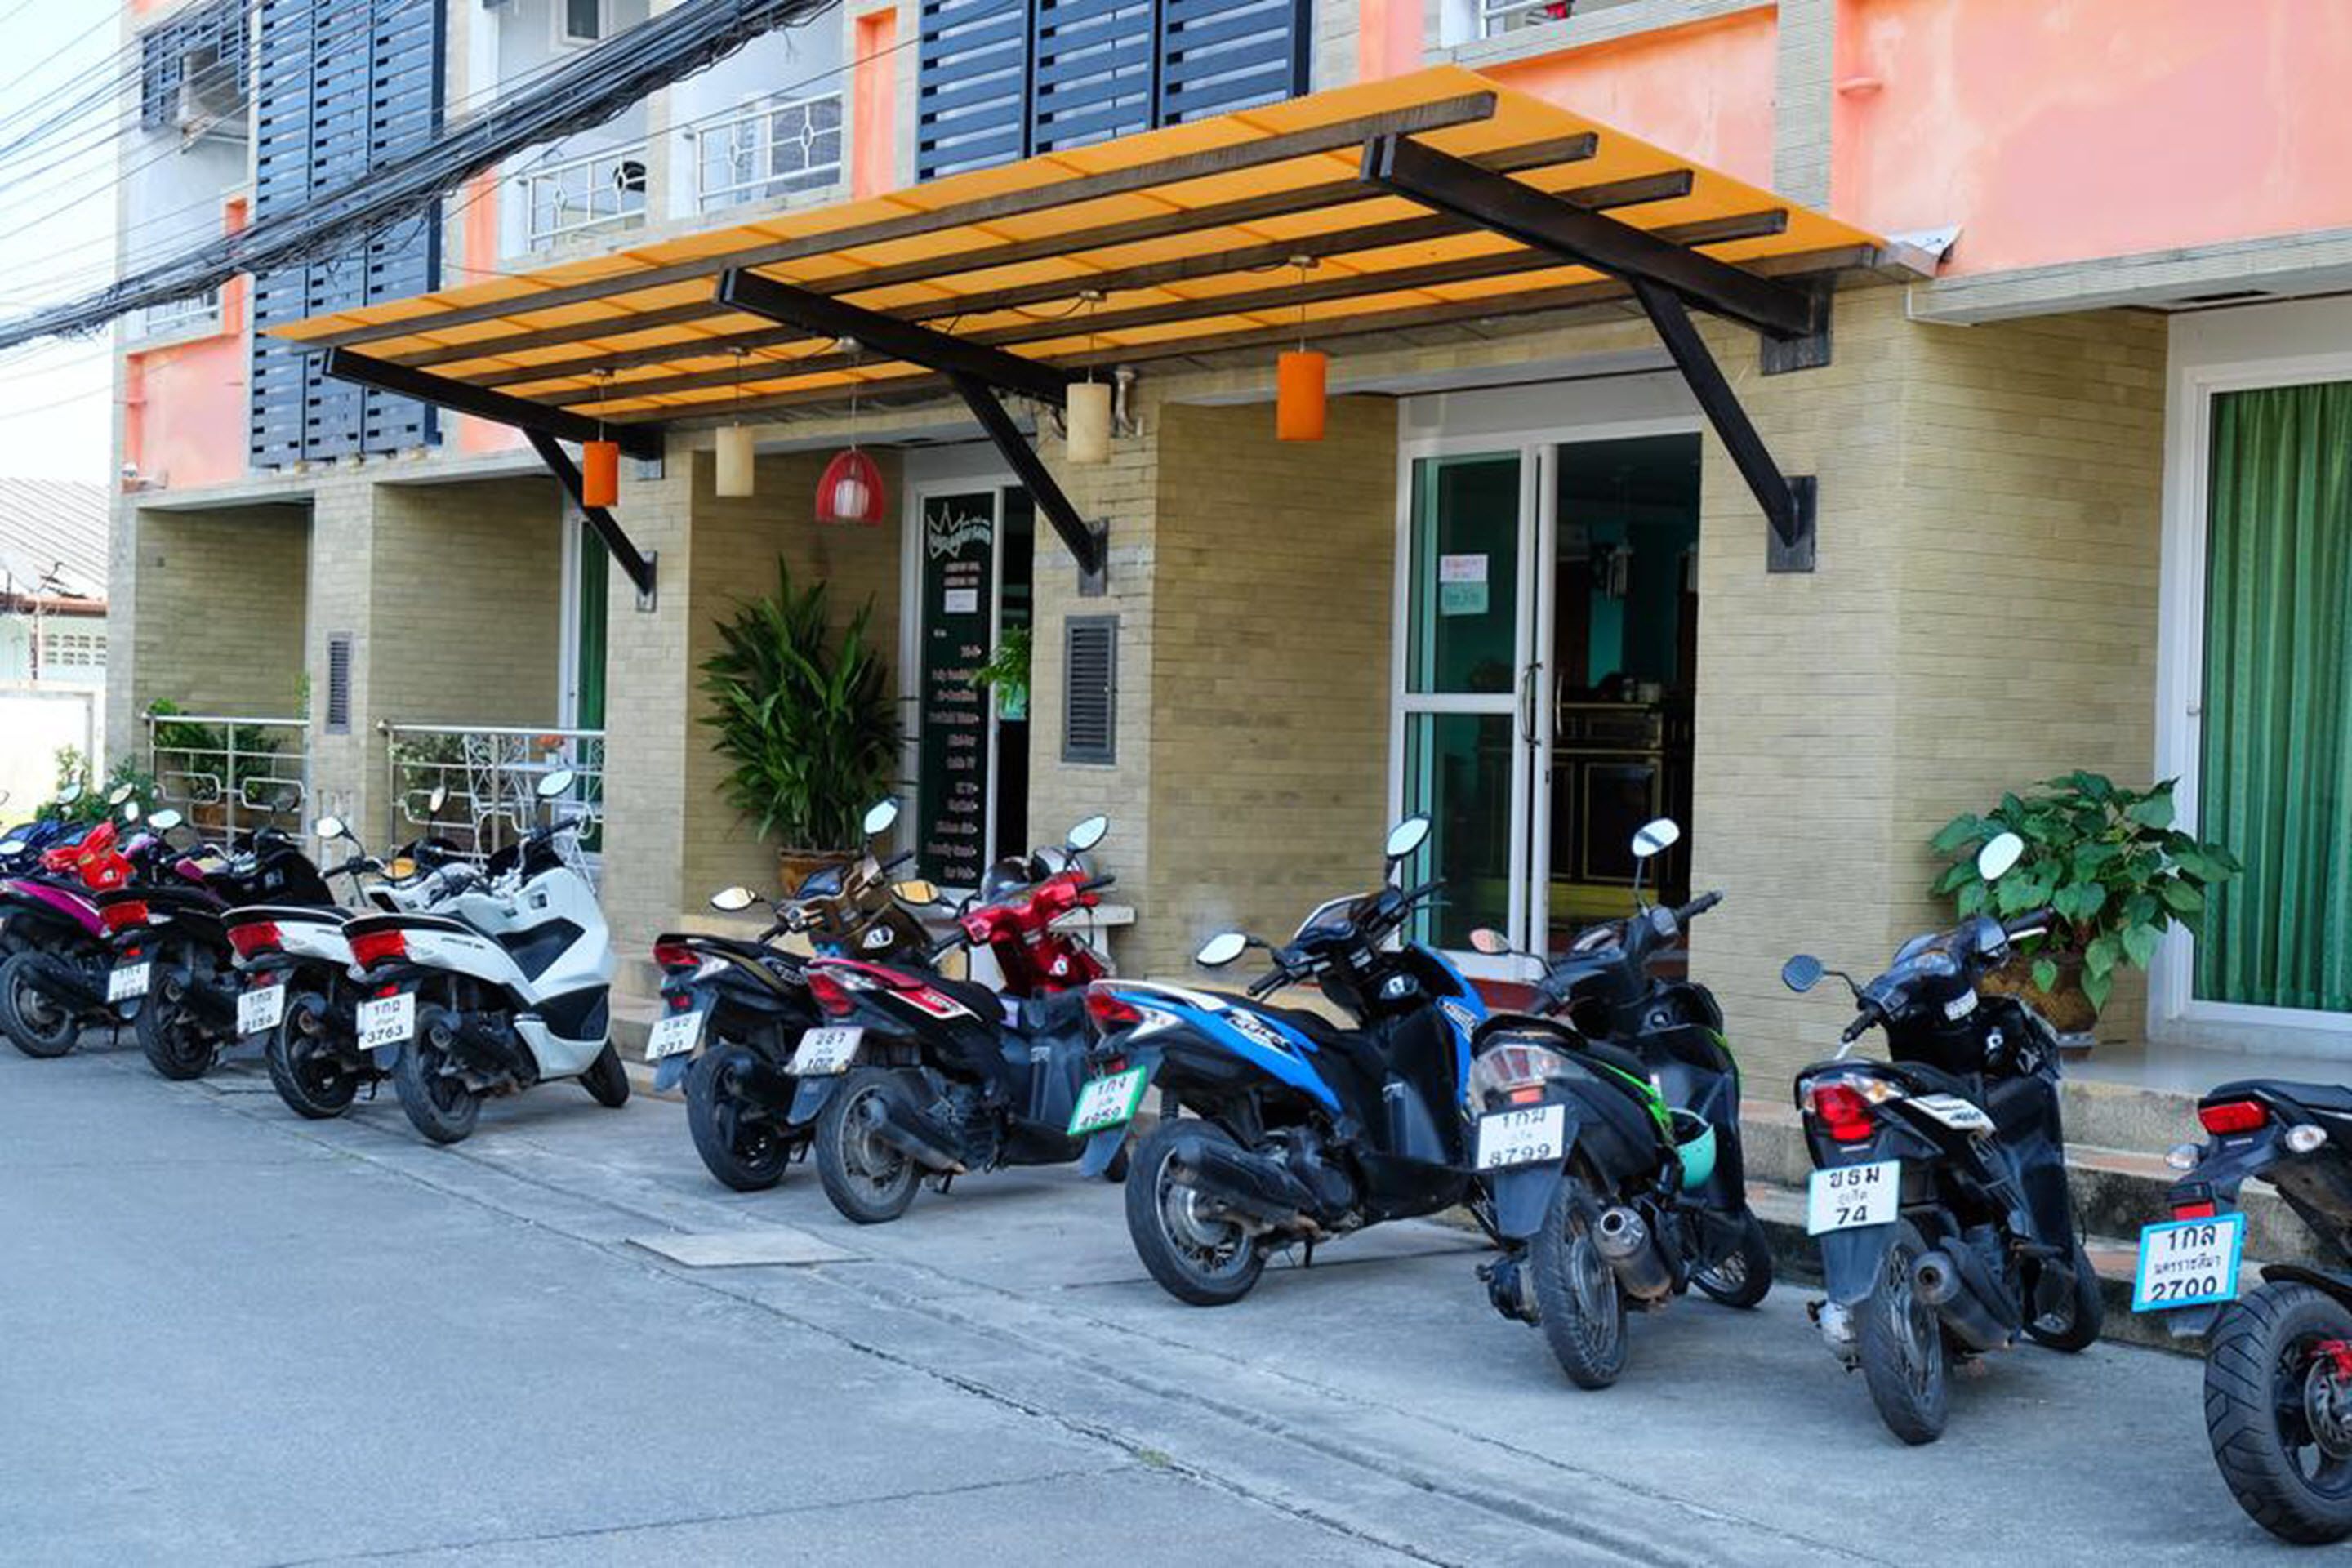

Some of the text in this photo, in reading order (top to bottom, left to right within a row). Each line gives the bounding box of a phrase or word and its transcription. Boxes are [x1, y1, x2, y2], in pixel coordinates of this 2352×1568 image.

[367, 1024, 403, 1044] 3763
[1488, 1143, 1551, 1168] 8799
[1829, 1166, 1880, 1188] ขธม
[1836, 1204, 1868, 1225] 74
[2168, 1225, 2216, 1250] 1กล
[2150, 1275, 2218, 1301] 2700
